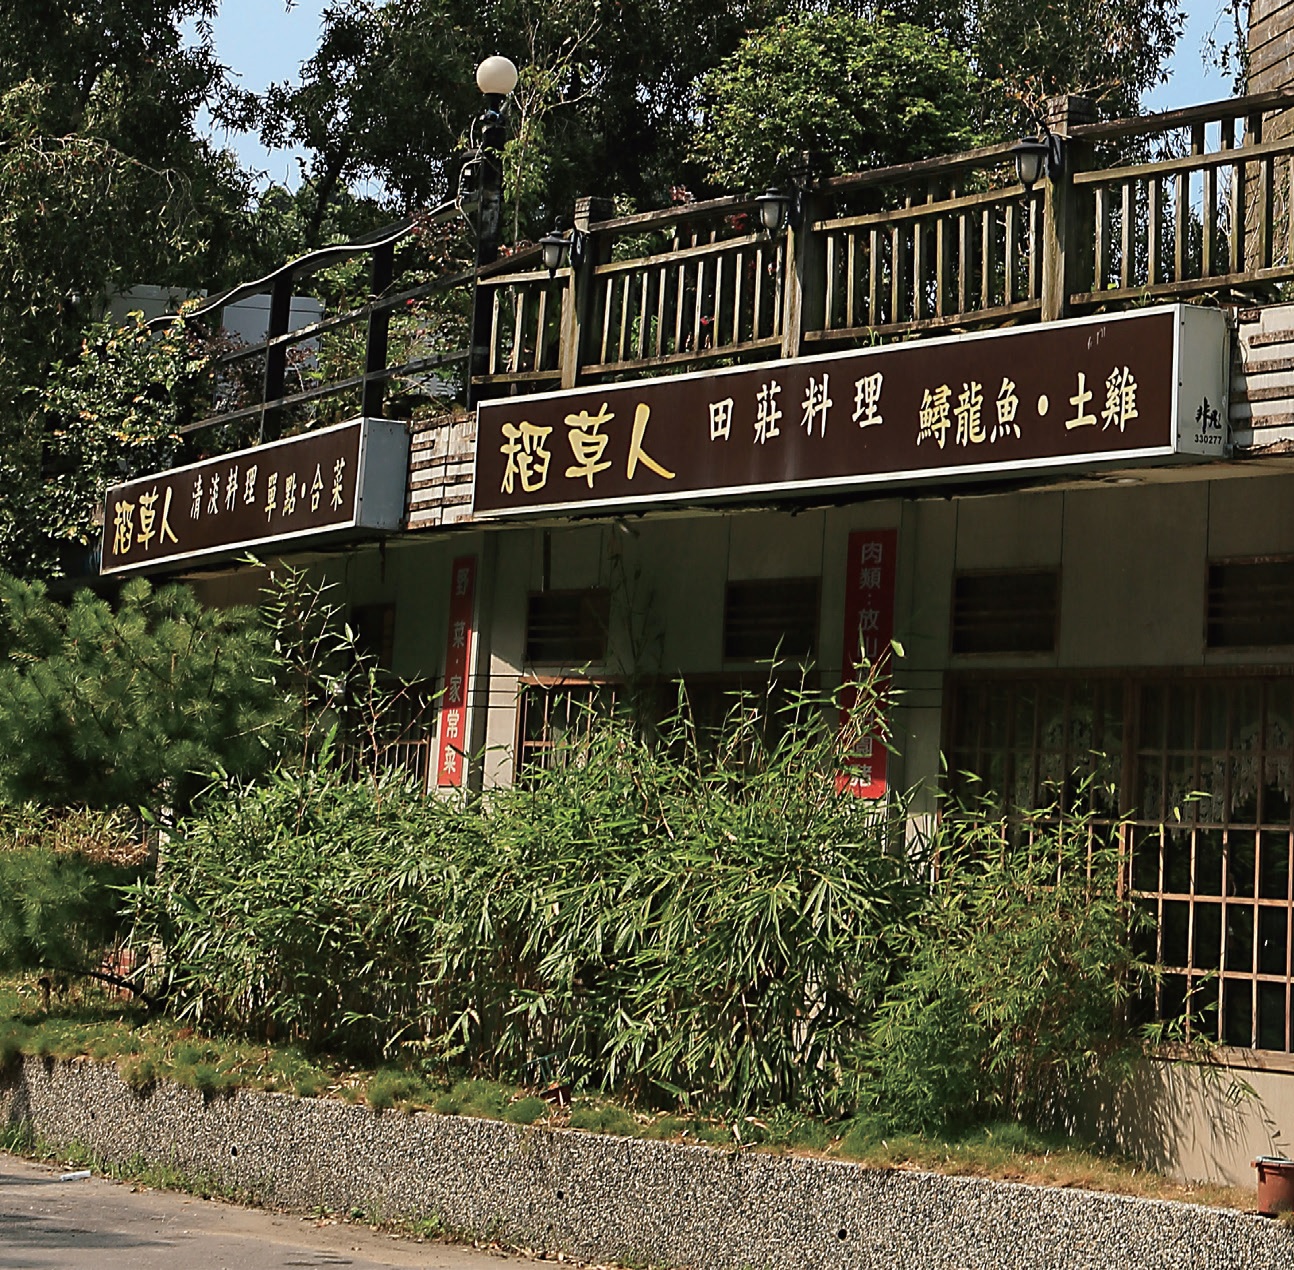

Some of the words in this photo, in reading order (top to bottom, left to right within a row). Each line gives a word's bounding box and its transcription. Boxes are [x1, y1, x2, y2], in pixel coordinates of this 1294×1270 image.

[500, 402, 676, 494] 稻草人
[709, 371, 884, 445] 田莊料理
[1194, 434, 1222, 445] 330277
[112, 486, 179, 555] 稻草人
